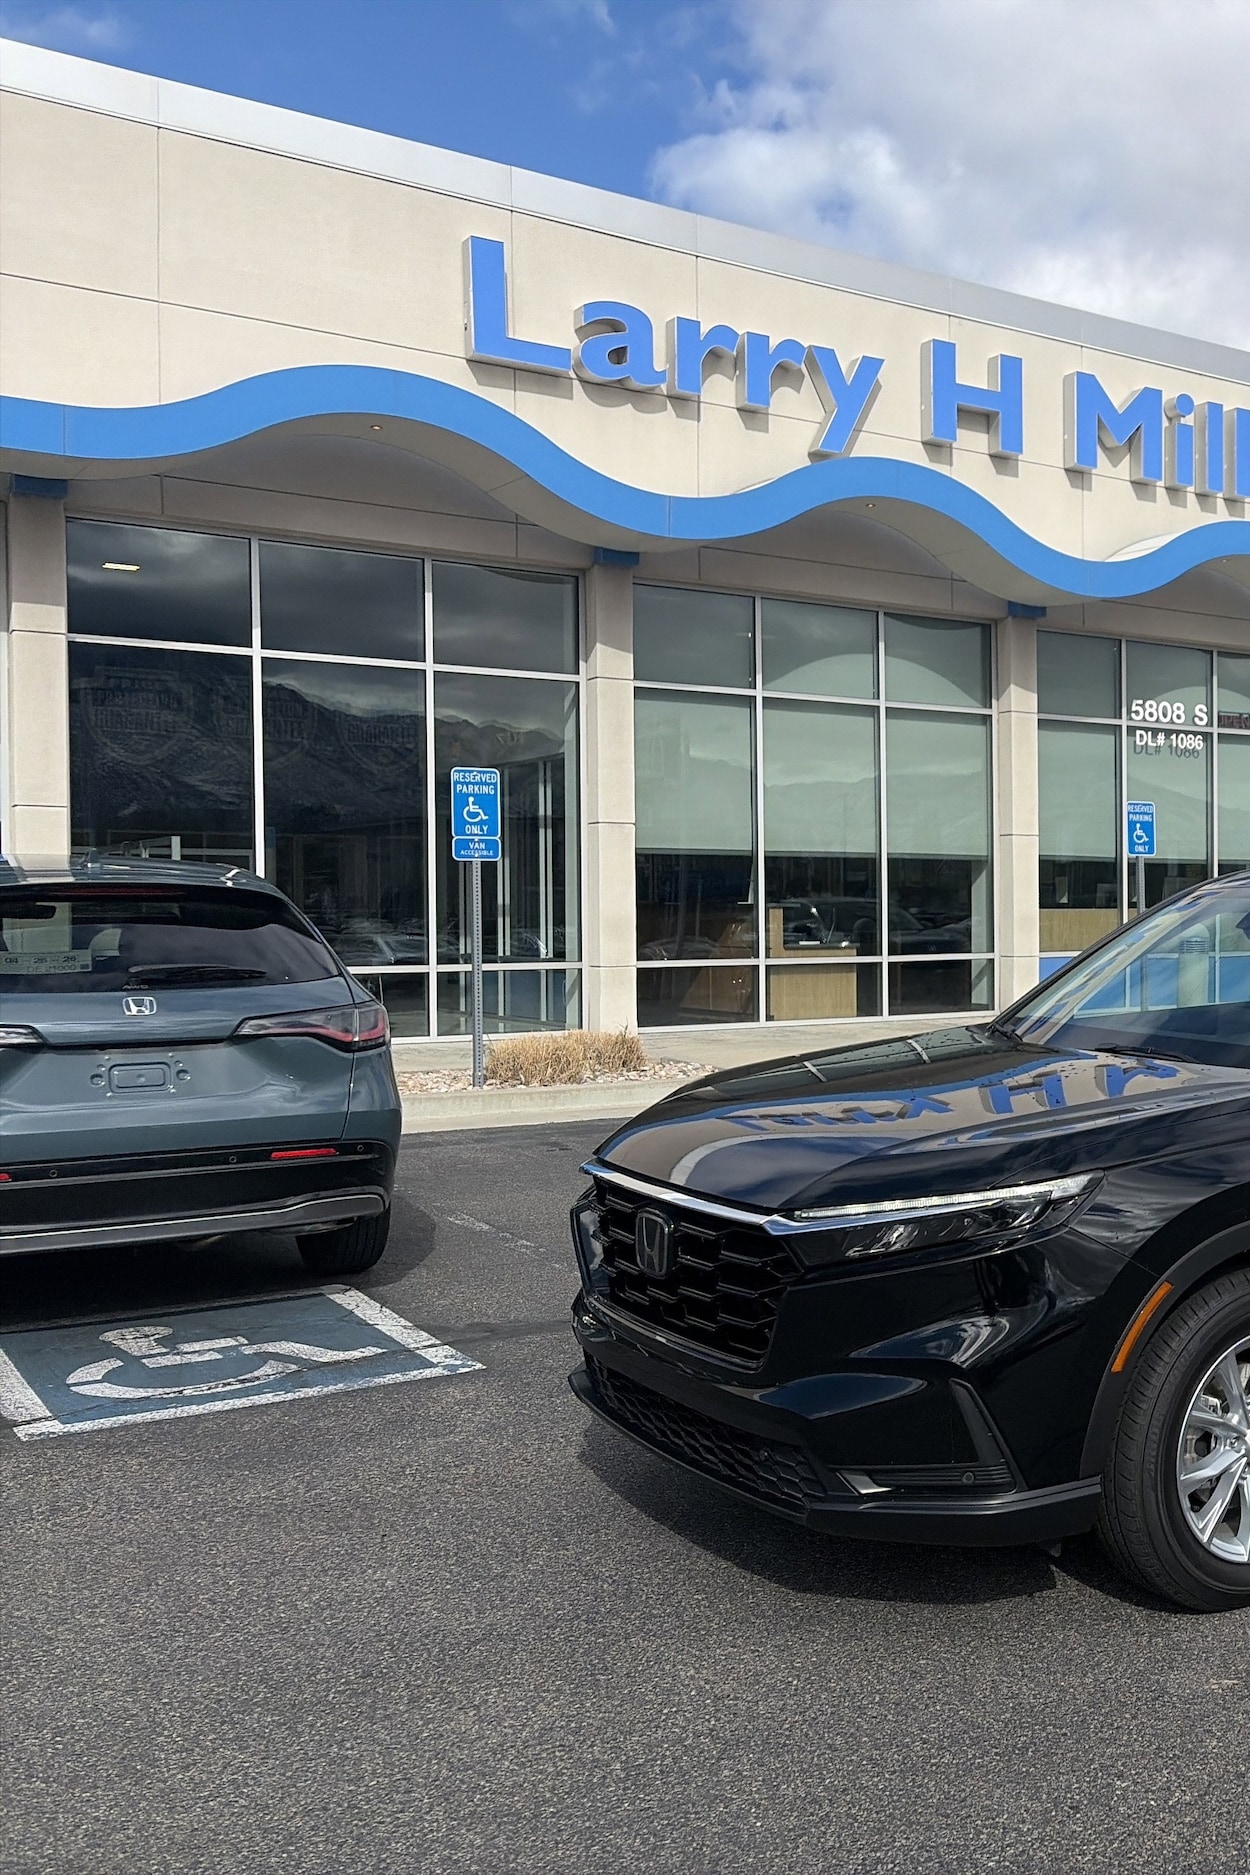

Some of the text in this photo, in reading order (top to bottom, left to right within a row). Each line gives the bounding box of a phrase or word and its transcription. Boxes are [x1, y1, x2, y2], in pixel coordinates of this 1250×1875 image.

[465, 235, 885, 455] Larry
[922, 338, 1023, 456] H
[1130, 699, 1208, 726] 5808 S
[1135, 729, 1204, 750] DL# 1086
[453, 772, 497, 783] RESERVED
[456, 784, 495, 795] PARKING
[1127, 804, 1154, 813] RESERVED
[1129, 813, 1153, 822] PARKING
[465, 824, 489, 835] ONLY
[468, 841, 486, 850] VAN
[1134, 844, 1150, 853] ONLY
